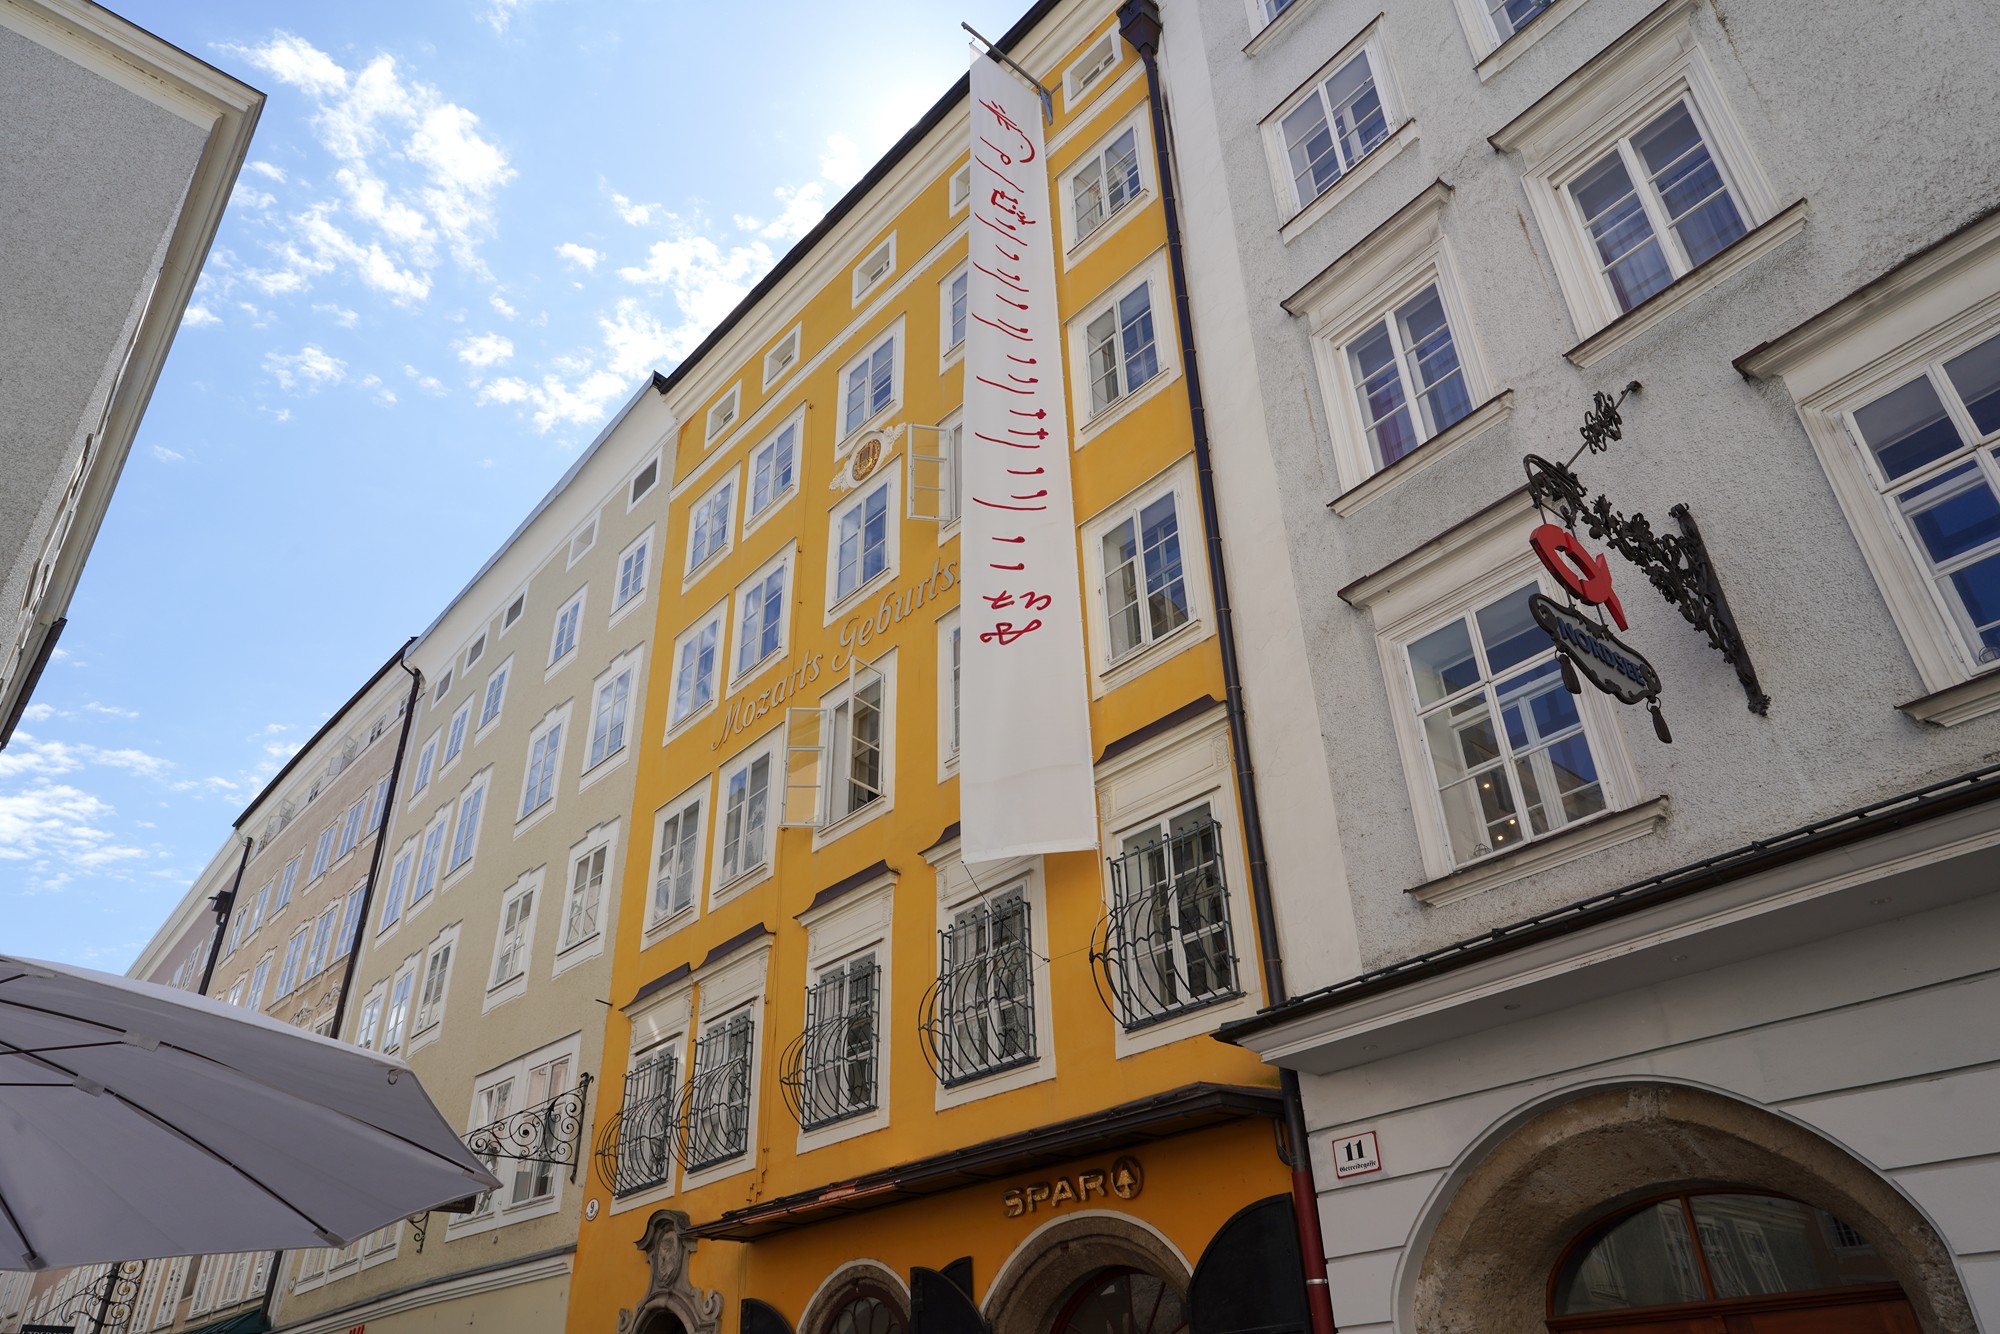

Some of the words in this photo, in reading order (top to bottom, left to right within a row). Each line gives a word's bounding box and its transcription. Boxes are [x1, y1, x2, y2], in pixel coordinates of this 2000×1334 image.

[711, 650, 823, 751] Mozarts
[832, 557, 961, 672] Geburts
[1555, 616, 1647, 687] NORDSEE
[1344, 1139, 1367, 1162] 11
[1003, 1168, 1107, 1217] SPAR
